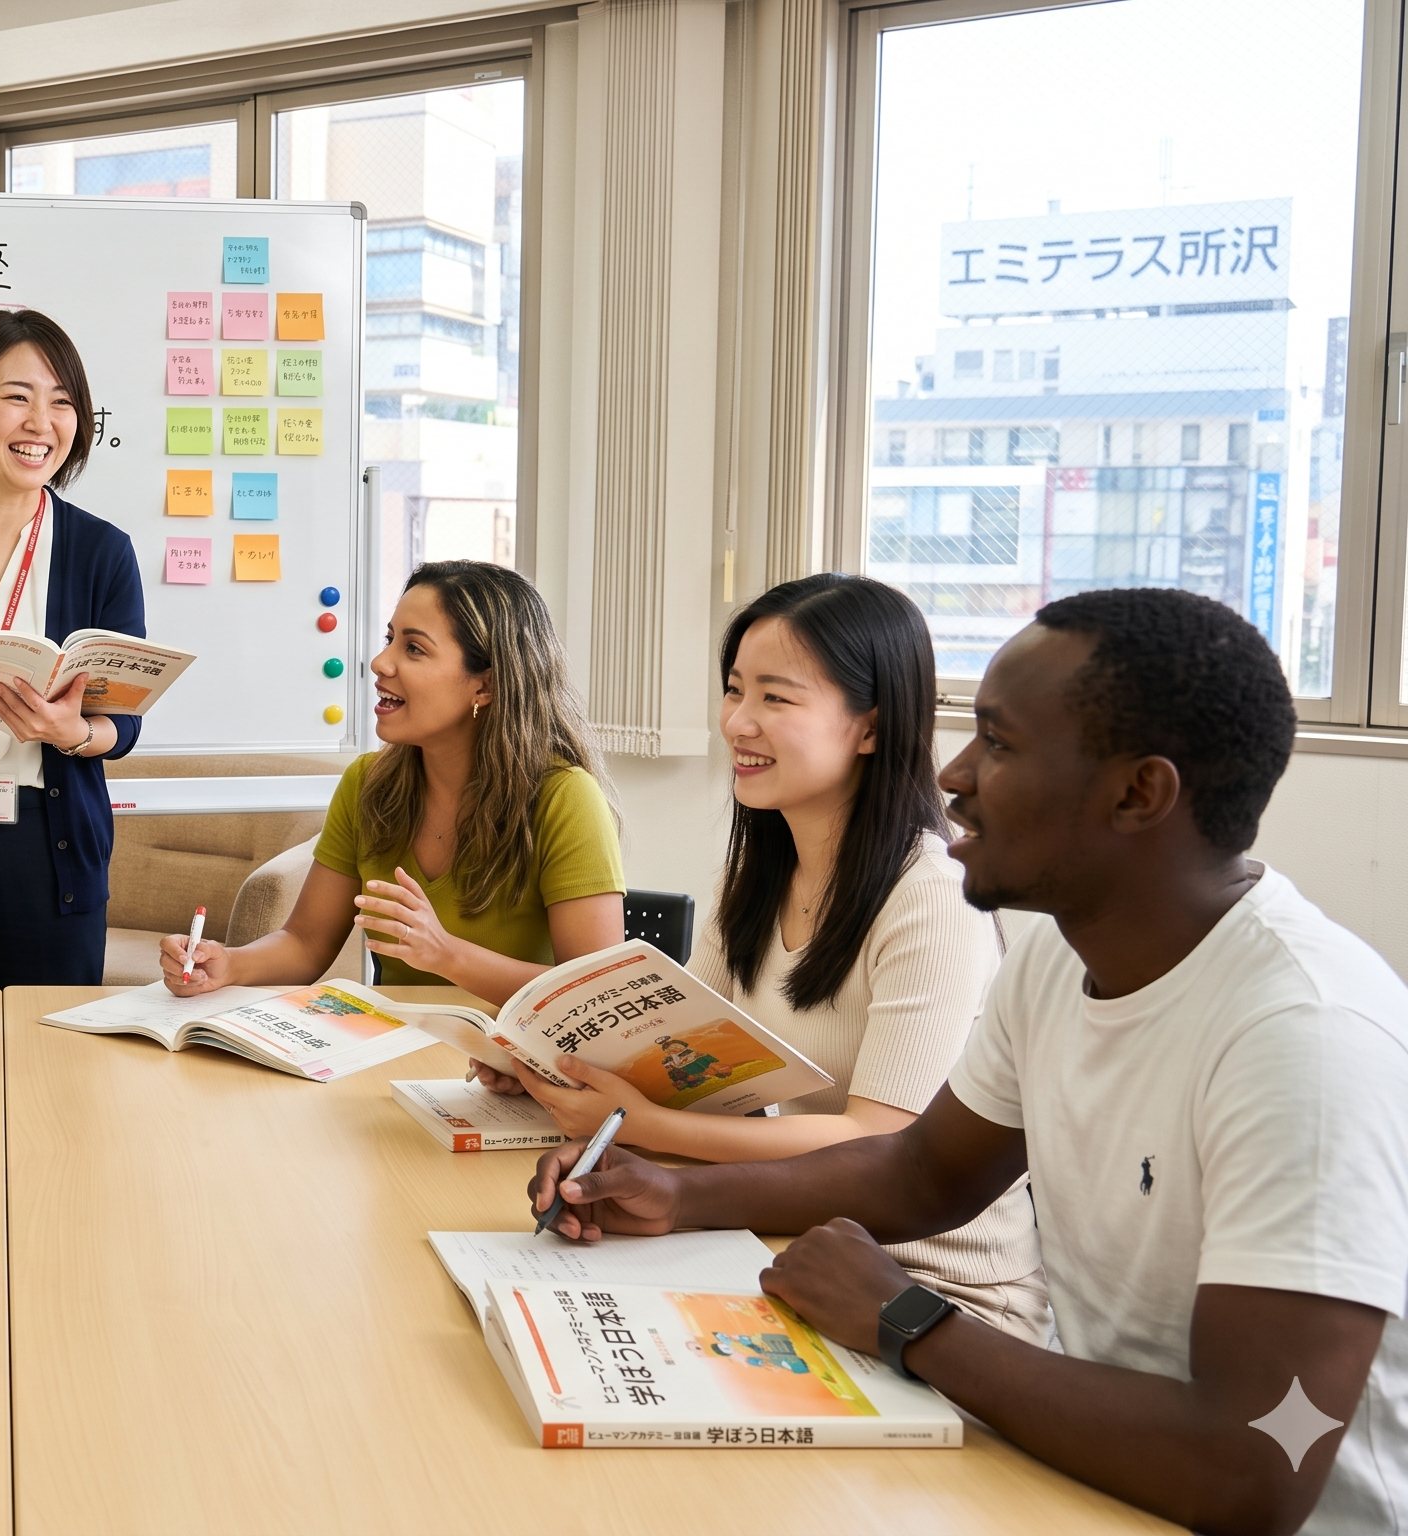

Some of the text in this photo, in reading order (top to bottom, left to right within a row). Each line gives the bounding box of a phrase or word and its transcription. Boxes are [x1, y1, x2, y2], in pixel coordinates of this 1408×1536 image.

[947, 225, 1280, 286] エミテラス所沢
[555, 984, 687, 1054] 学ぼう日本語
